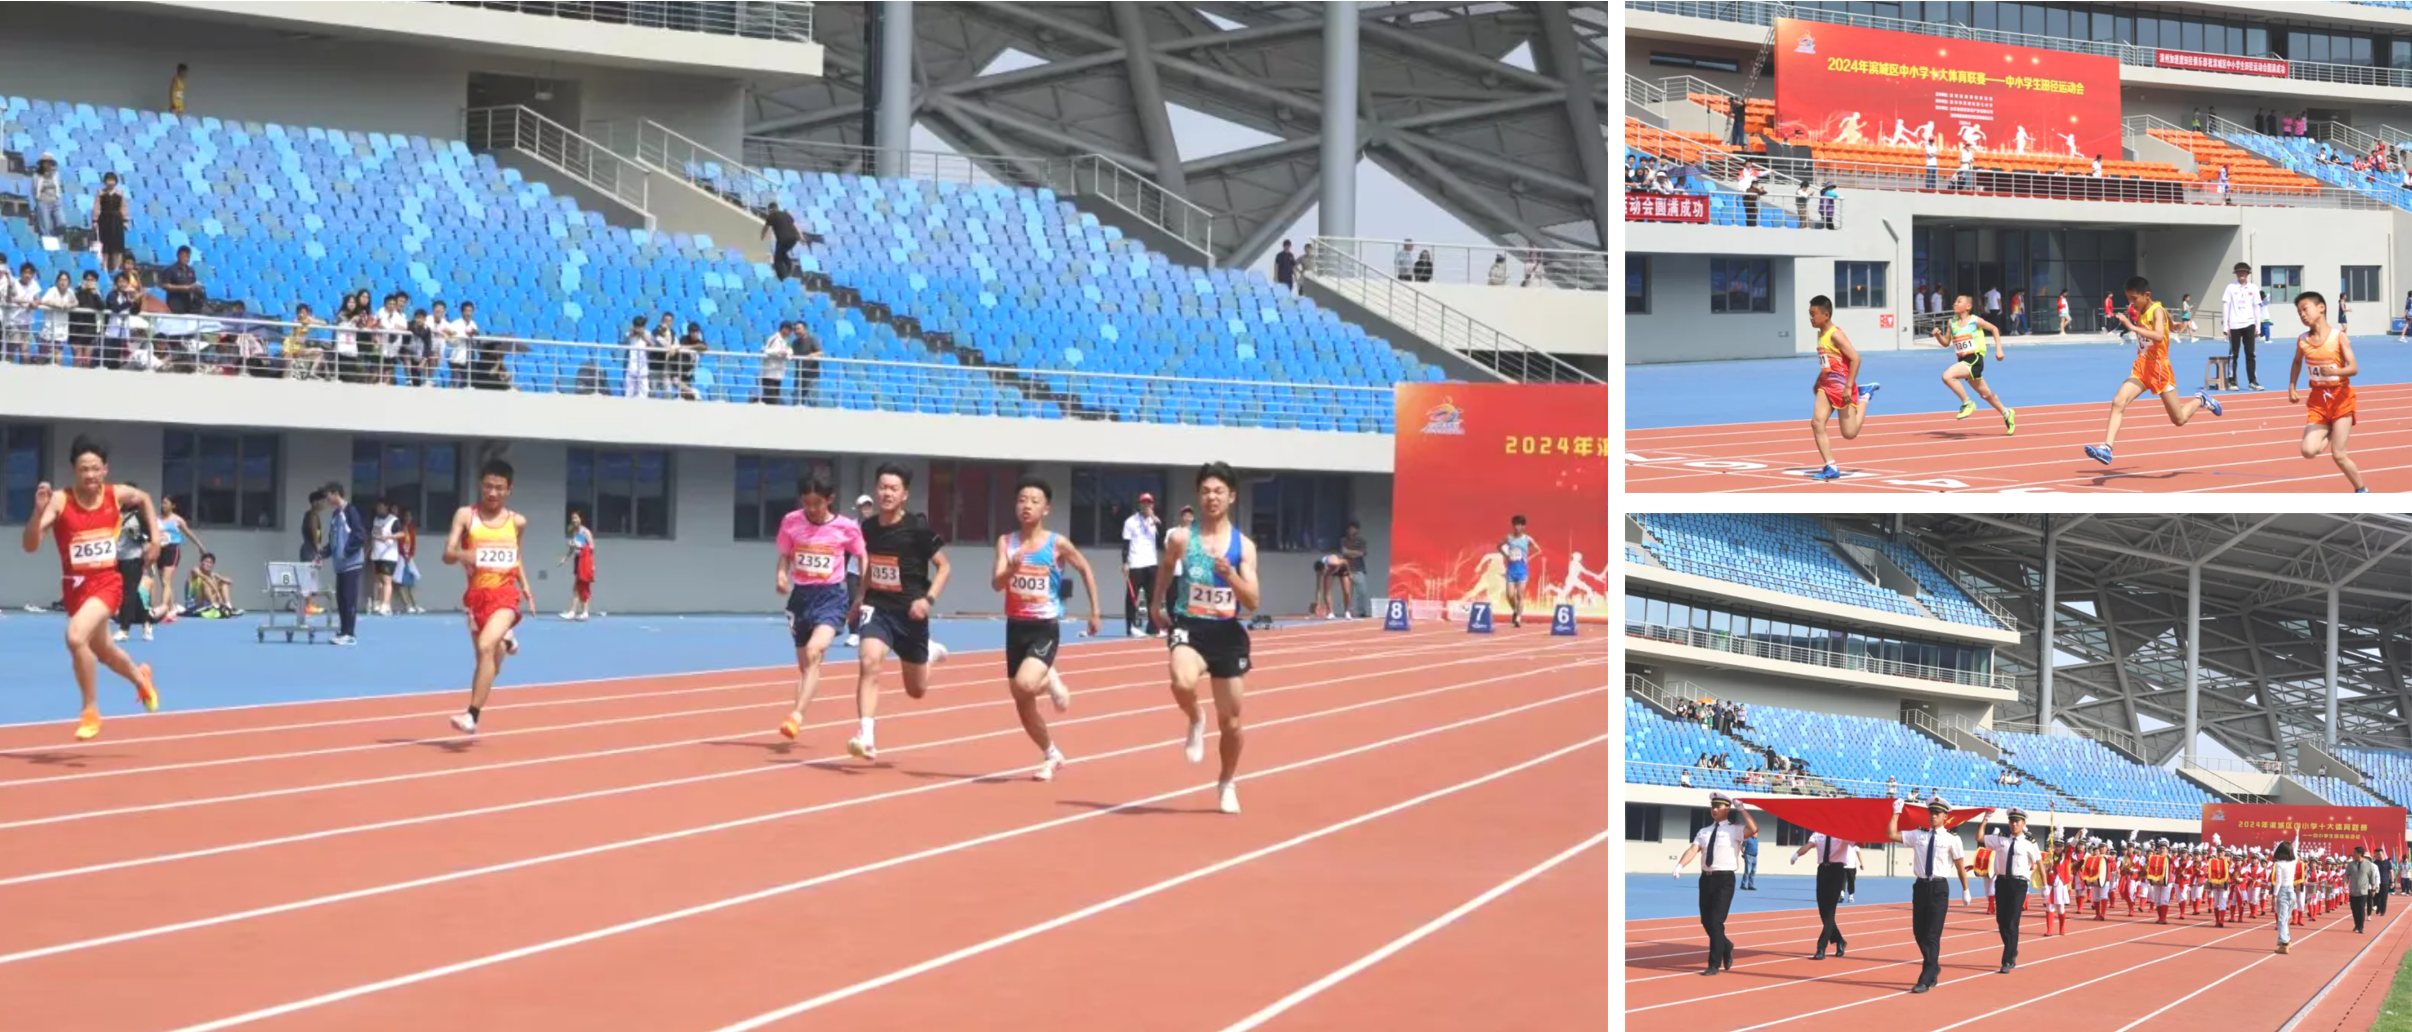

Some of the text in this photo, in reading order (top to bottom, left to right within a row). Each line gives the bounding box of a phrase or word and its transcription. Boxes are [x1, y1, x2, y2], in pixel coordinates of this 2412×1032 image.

[1625, 196, 1704, 217] 动会圆满成功
[73, 541, 113, 559] 2652
[480, 550, 514, 563] 2203
[797, 554, 831, 569] 2352
[282, 573, 290, 586] 8
[1010, 575, 1045, 591] 2003
[1193, 586, 1233, 604] 2151
[1390, 602, 1404, 620] 8
[1474, 604, 1487, 622] 7
[1556, 606, 1570, 624] 6
